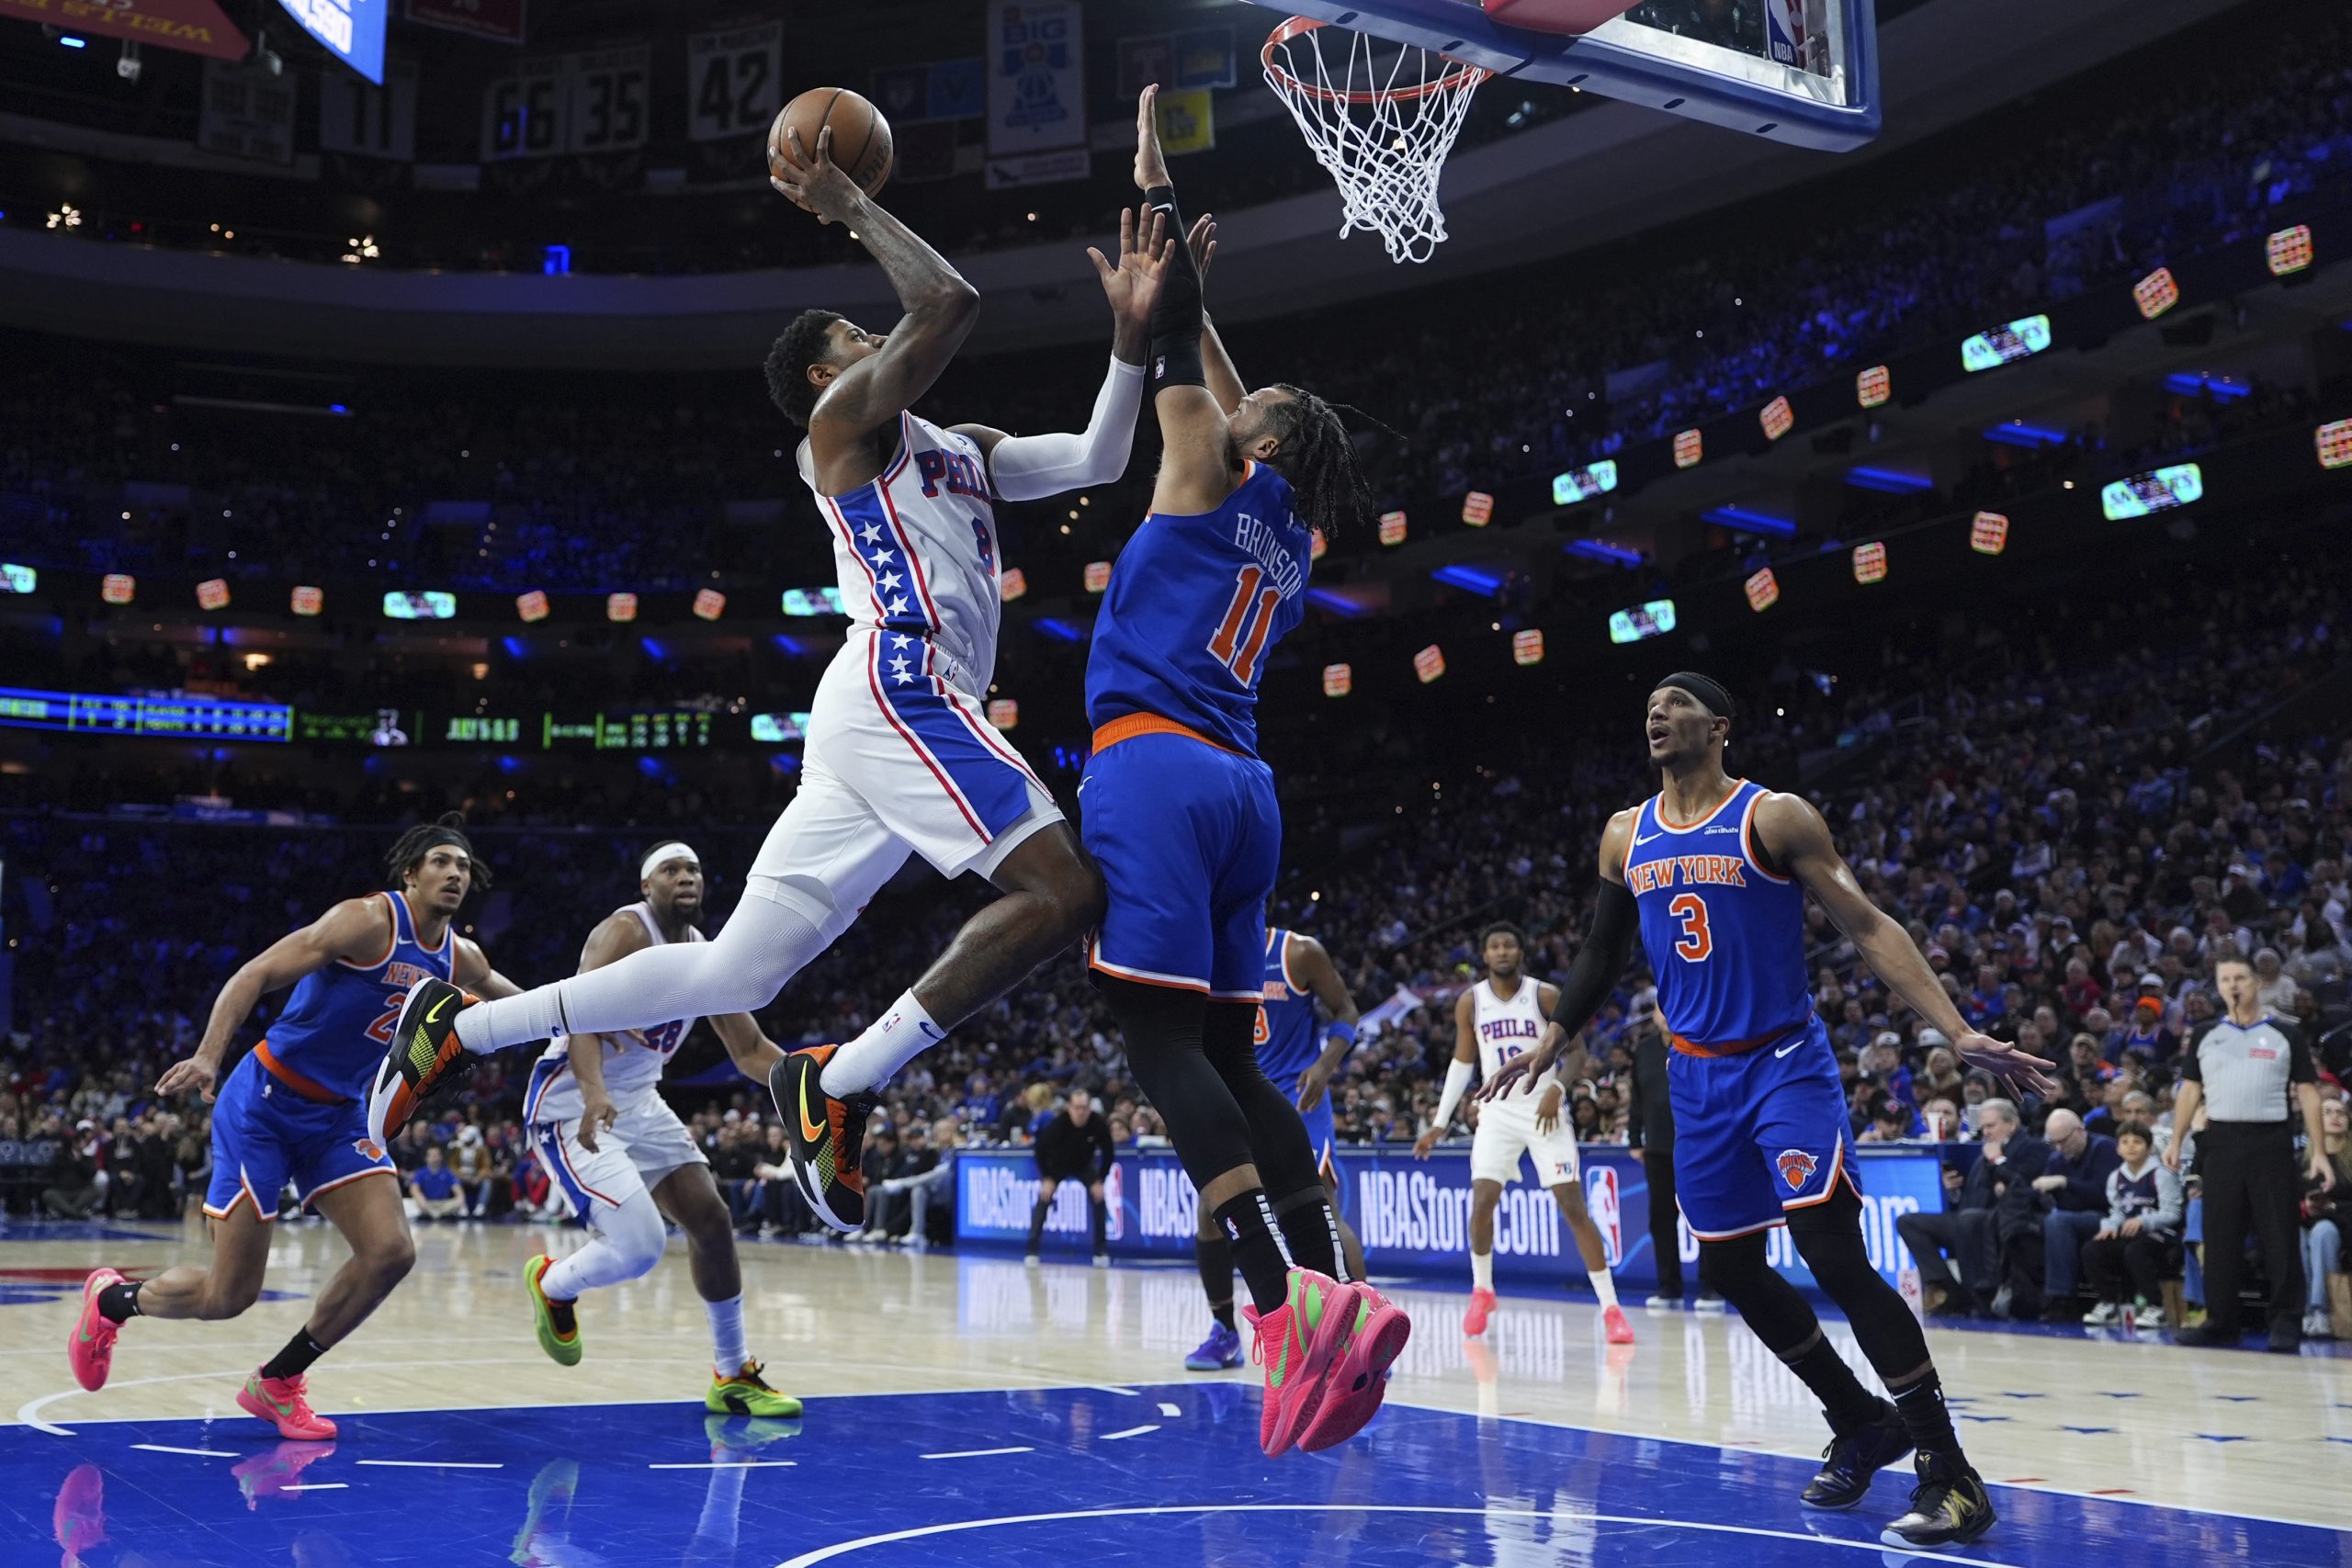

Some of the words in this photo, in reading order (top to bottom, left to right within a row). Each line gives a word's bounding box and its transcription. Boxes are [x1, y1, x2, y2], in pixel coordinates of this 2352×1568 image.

[1774, 41, 1793, 62] NBA
[698, 52, 770, 130] 42
[972, 517, 995, 578] 8
[1235, 513, 1304, 600] BRUNSON
[1206, 563, 1284, 690] 11
[1629, 856, 1676, 897] NEW
[1677, 854, 1747, 888] YORK
[1669, 892, 1713, 963] 3
[367, 991, 407, 1045] 2
[1480, 1019, 1539, 1043] PHILA
[1555, 1161, 1573, 1176] 76
